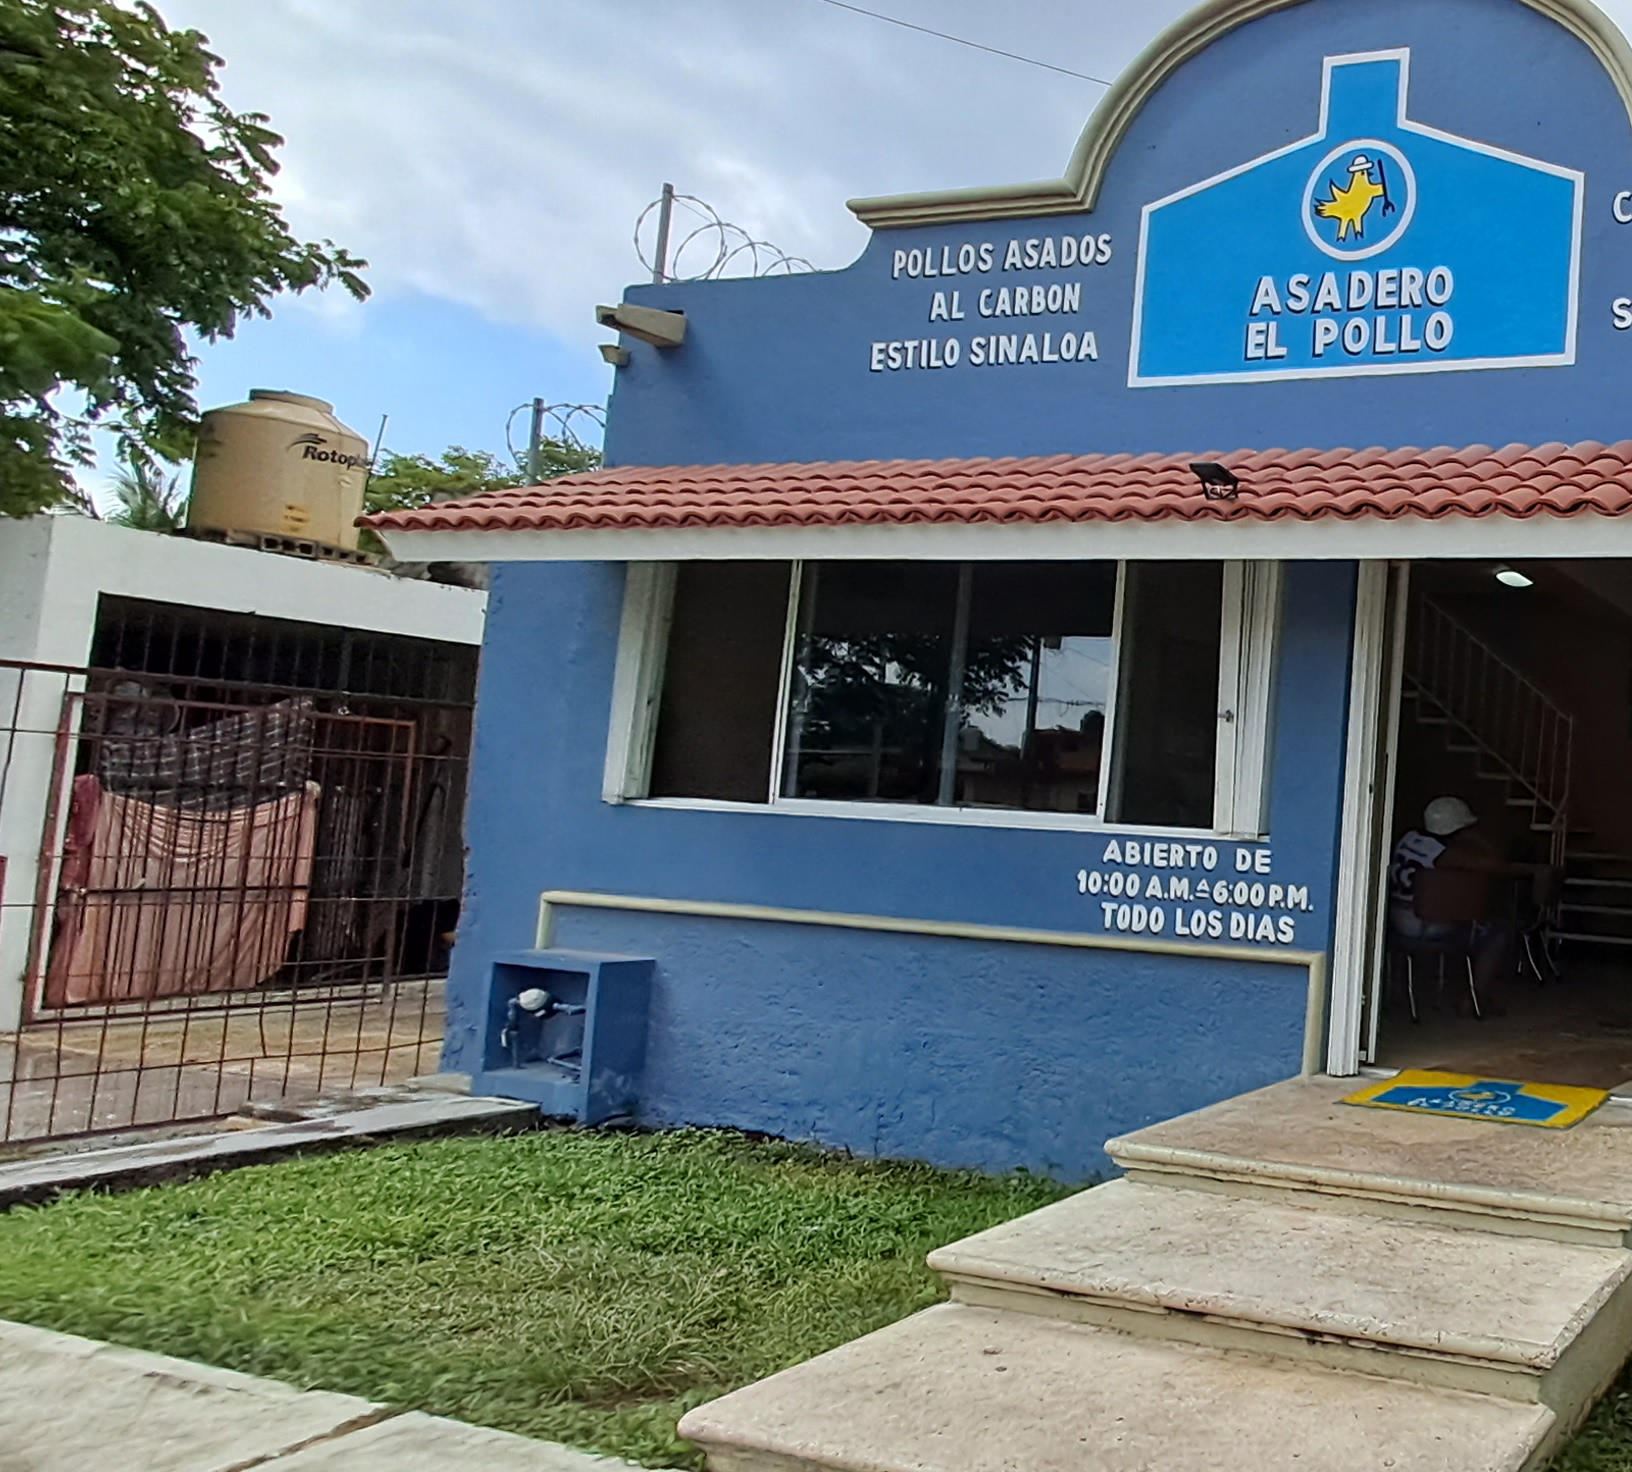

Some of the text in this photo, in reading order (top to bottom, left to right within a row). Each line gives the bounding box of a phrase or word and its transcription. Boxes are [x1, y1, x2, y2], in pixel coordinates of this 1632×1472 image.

[892, 233, 1112, 279] POLLOS ASADOS
[929, 282, 1081, 321] AL CARBON
[1249, 265, 1454, 315] ASADERO
[869, 331, 1098, 372] ESTILO SINALOA
[1245, 311, 1454, 360] EL POLLO
[1102, 839, 1272, 874] ABIERTO DE
[1076, 868, 1140, 898] 10:00
[1212, 879, 1265, 906] 6:00
[1268, 884, 1315, 911] P.M.
[1101, 901, 1296, 944] TODO LOS DIAS
